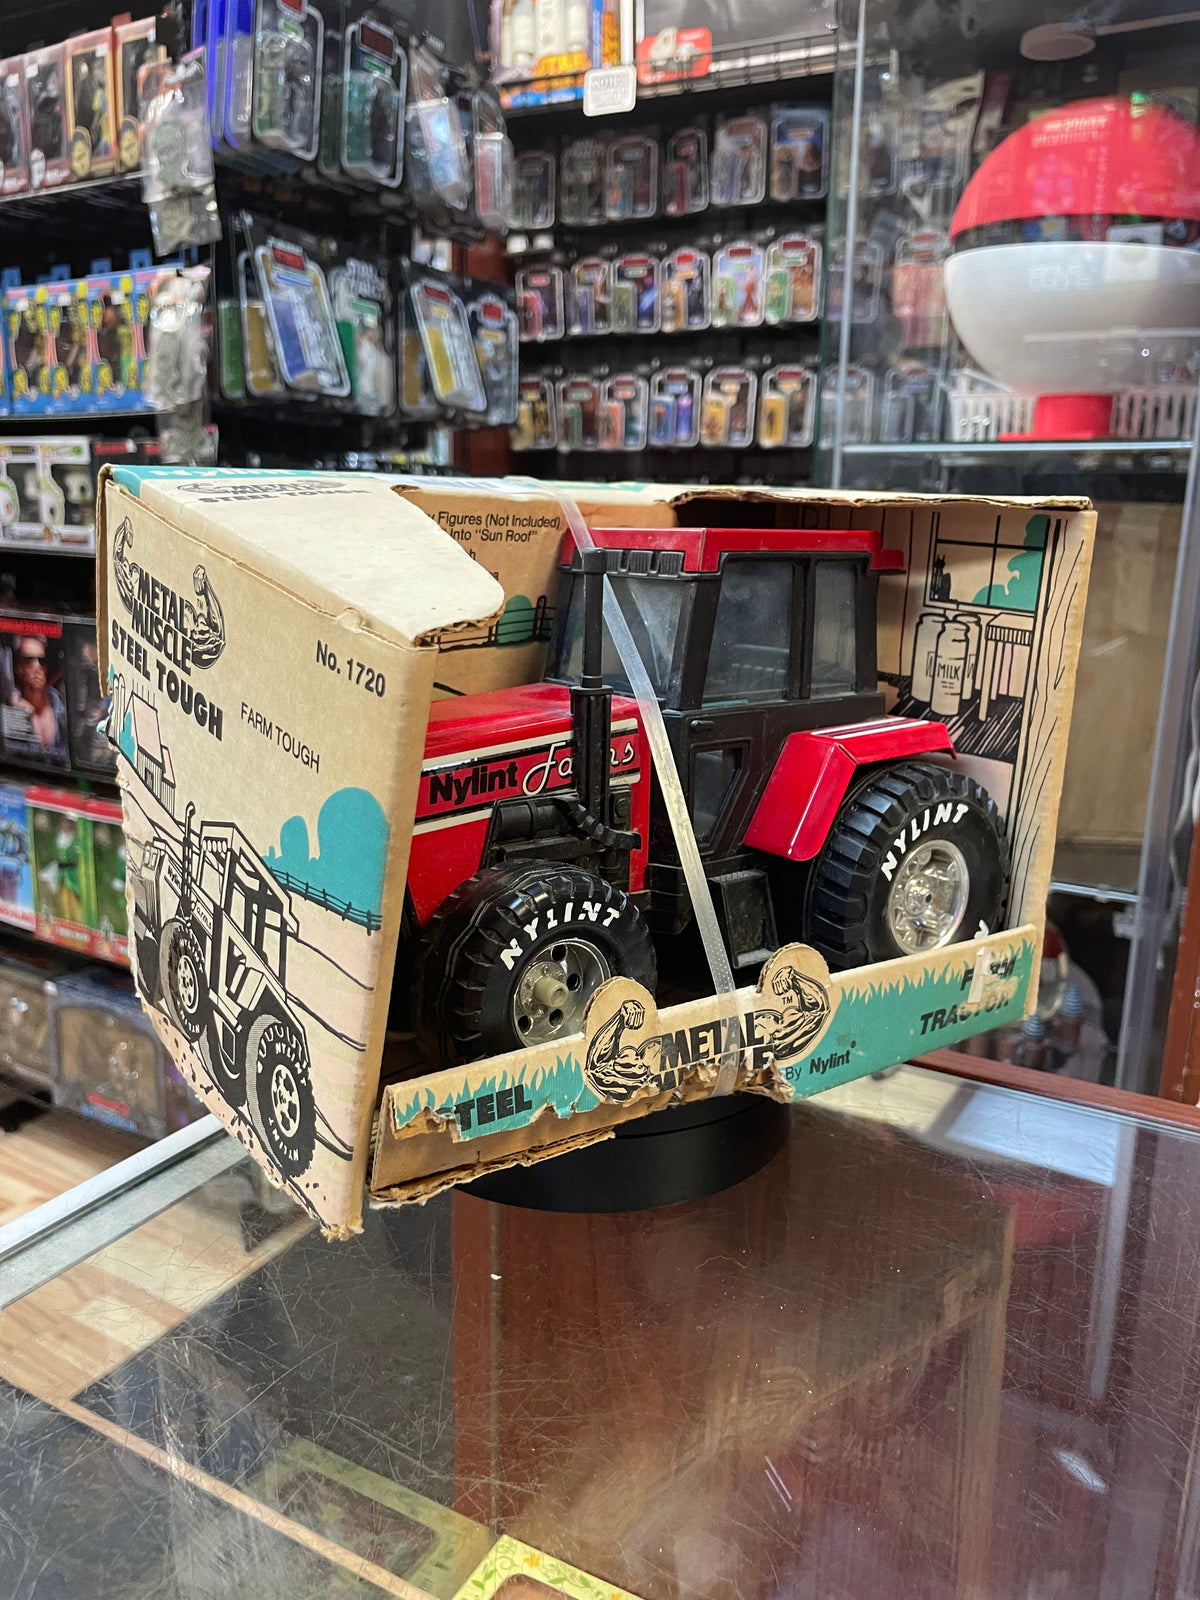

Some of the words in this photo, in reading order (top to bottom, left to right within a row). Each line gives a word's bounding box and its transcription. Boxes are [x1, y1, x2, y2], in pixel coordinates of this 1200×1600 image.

[438, 510, 482, 527] Figures
[485, 513, 510, 529] (Not
[137, 567, 189, 635] METAL
[131, 597, 193, 677] MUSCLE
[112, 619, 151, 682] STEEL
[156, 658, 224, 742] TOUGH
[315, 639, 341, 676] No.
[346, 658, 386, 699] 1720
[936, 662, 962, 681] MILK
[240, 701, 274, 741] FARM
[275, 725, 321, 774] TOUGH
[429, 761, 518, 805] Nylint
[880, 802, 970, 882] NYLINT
[500, 901, 621, 971] NYLINT
[782, 995, 793, 1006] TM
[275, 1041, 308, 1087] NYLINT
[659, 1012, 764, 1072] METAL
[785, 1066, 802, 1081] By
